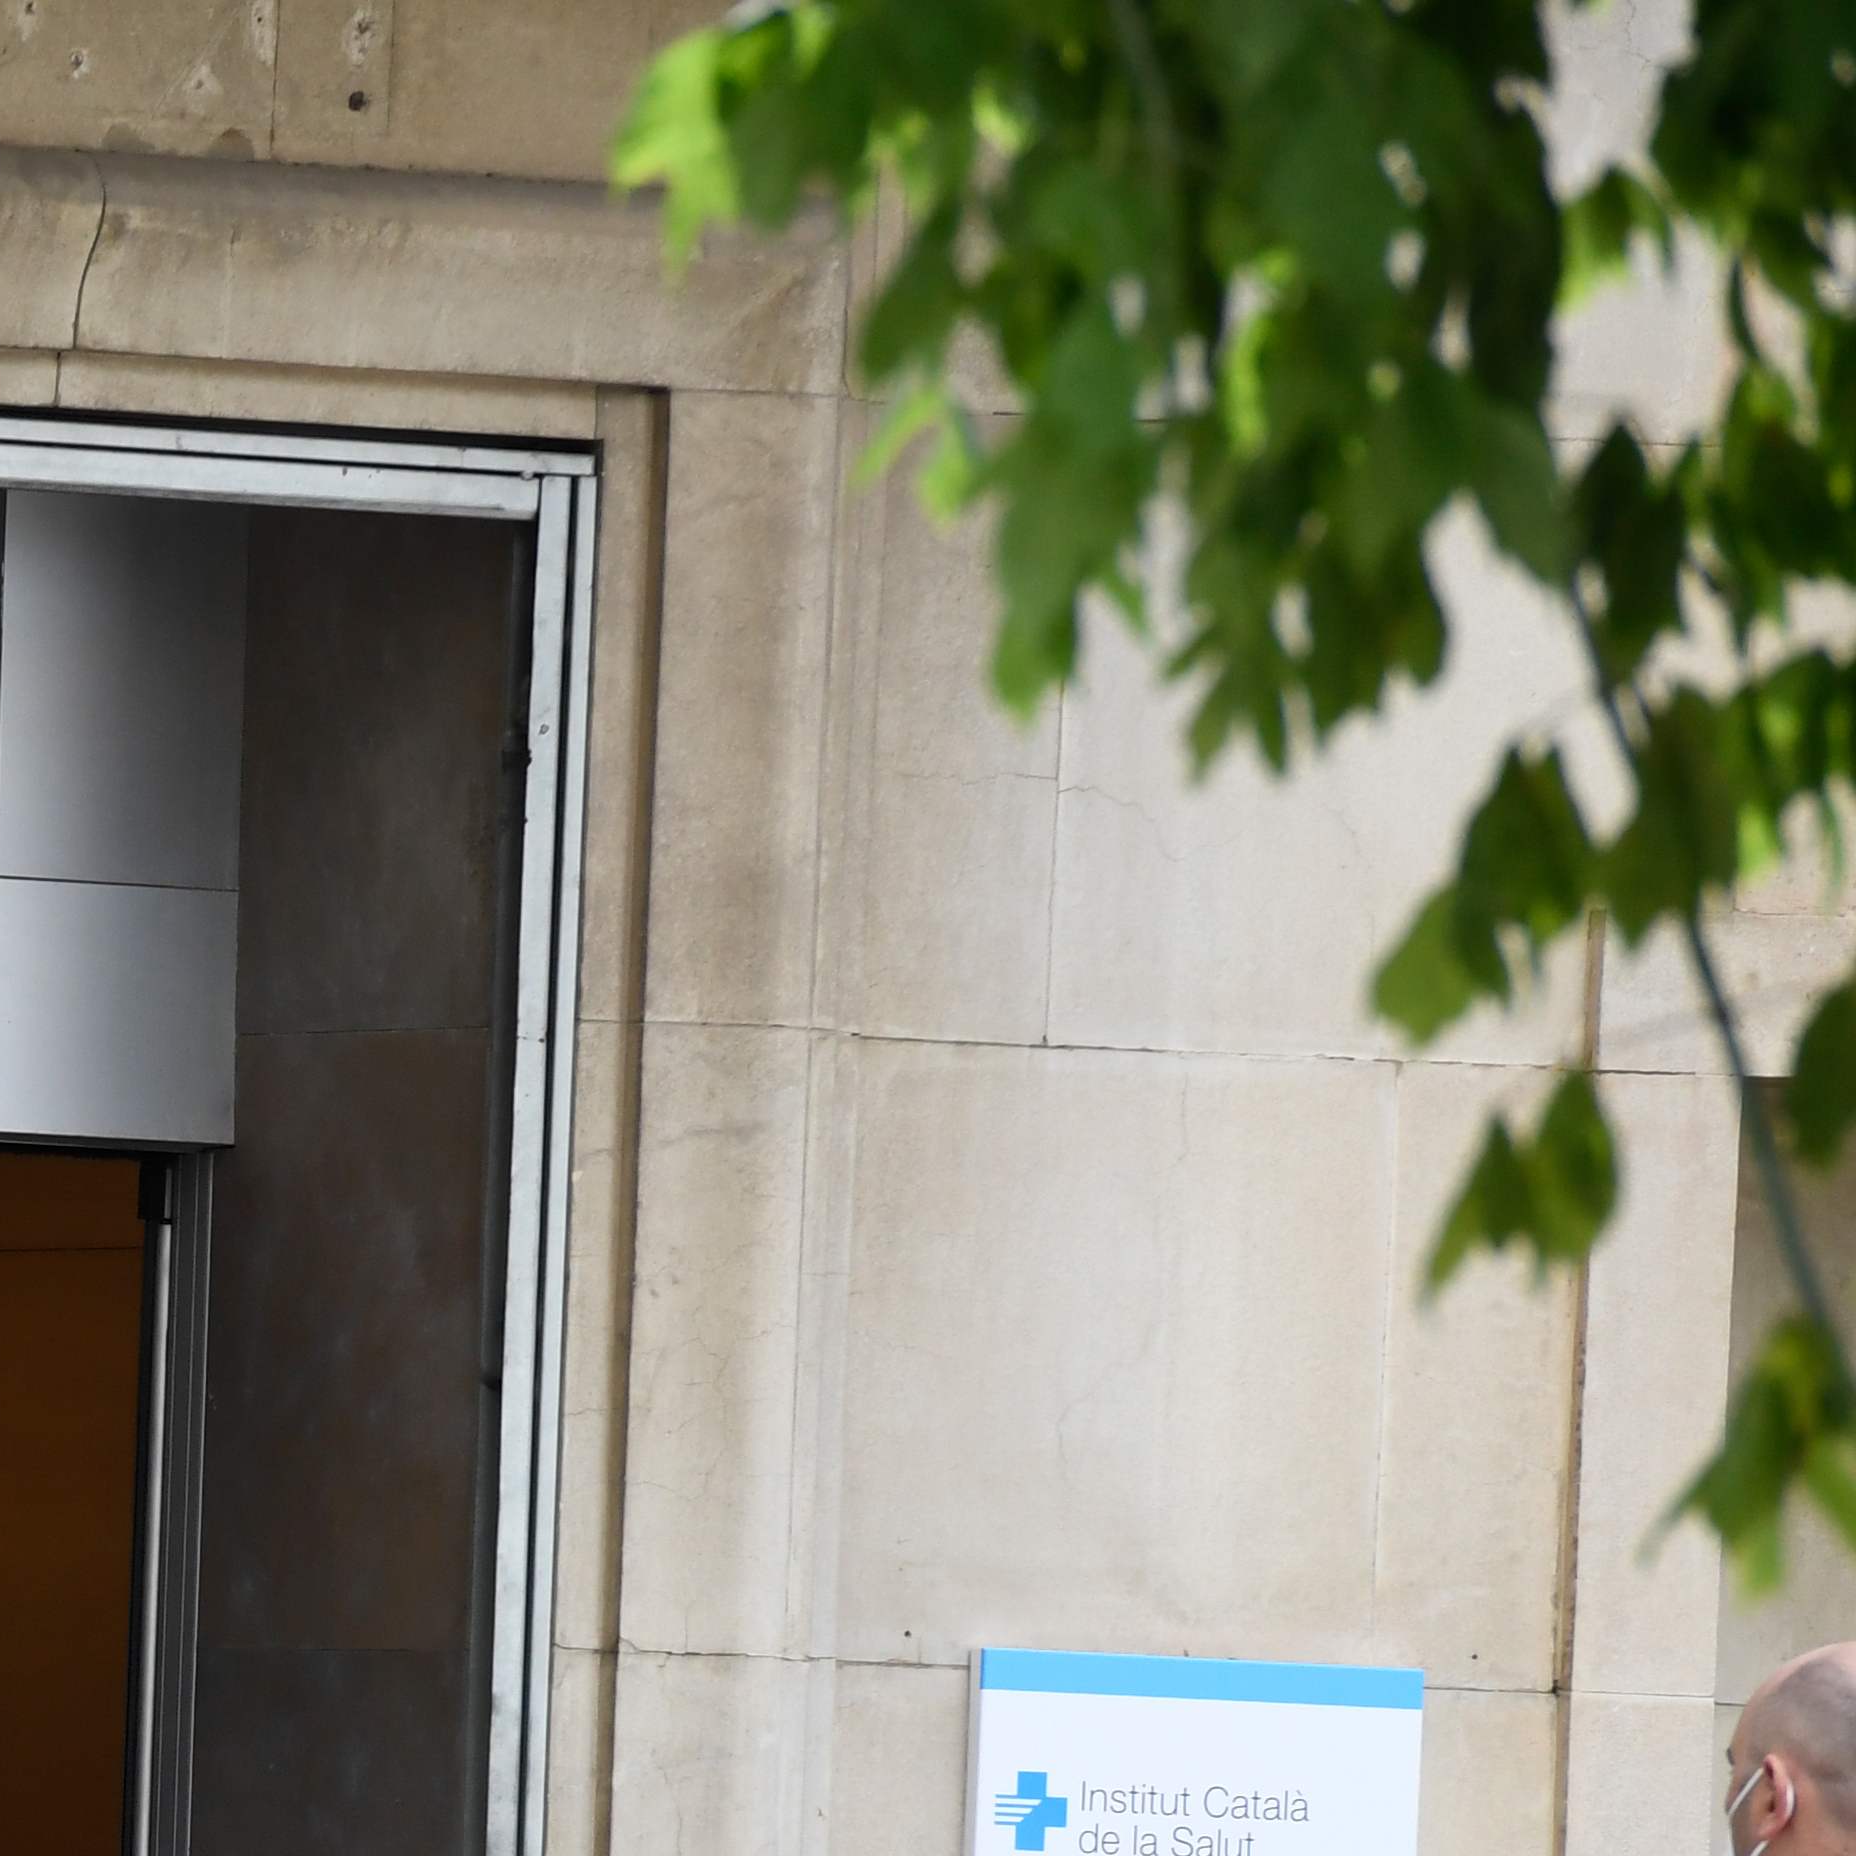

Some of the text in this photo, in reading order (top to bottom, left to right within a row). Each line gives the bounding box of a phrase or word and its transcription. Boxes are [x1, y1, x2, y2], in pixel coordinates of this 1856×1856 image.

[1081, 1781, 1310, 1823] Institut Català
[1078, 1824, 1121, 1856] de
[1134, 1826, 1159, 1856] la
